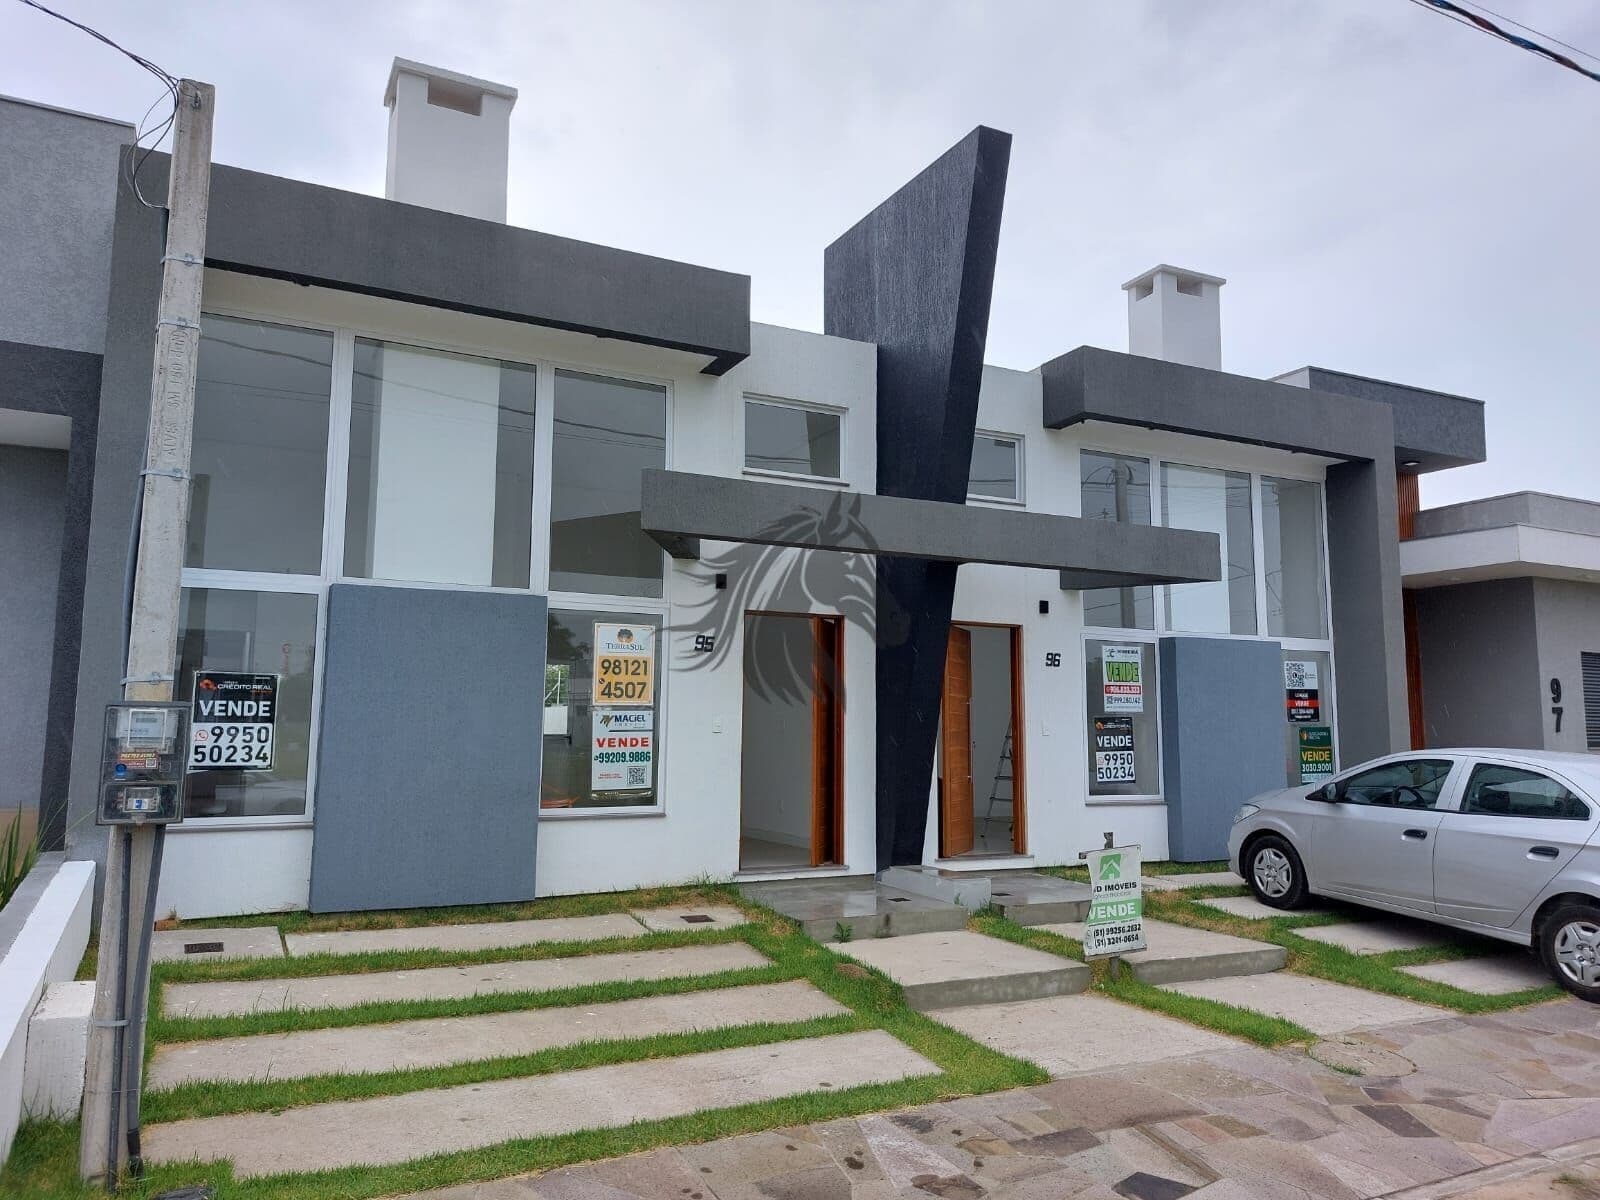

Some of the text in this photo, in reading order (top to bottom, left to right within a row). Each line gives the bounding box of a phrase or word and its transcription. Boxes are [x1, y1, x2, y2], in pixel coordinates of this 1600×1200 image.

[694, 635, 715, 652] 95
[601, 658, 648, 676] 98121
[1045, 652, 1061, 667] 96
[1105, 661, 1140, 683] VENDE
[600, 681, 647, 699] 4507
[200, 700, 271, 717] VENDE
[1550, 678, 1563, 733] 97
[211, 726, 270, 744] 9950
[597, 737, 649, 748] VENDE
[1097, 735, 1132, 748] VENDE
[193, 745, 269, 763] 50234
[1104, 753, 1133, 766] 9950
[1301, 751, 1330, 761] VENDE
[1097, 766, 1134, 779] 50234
[1089, 902, 1136, 920] VENDE
[1093, 928, 1105, 938] (51)
[1094, 937, 1106, 949] (51)
